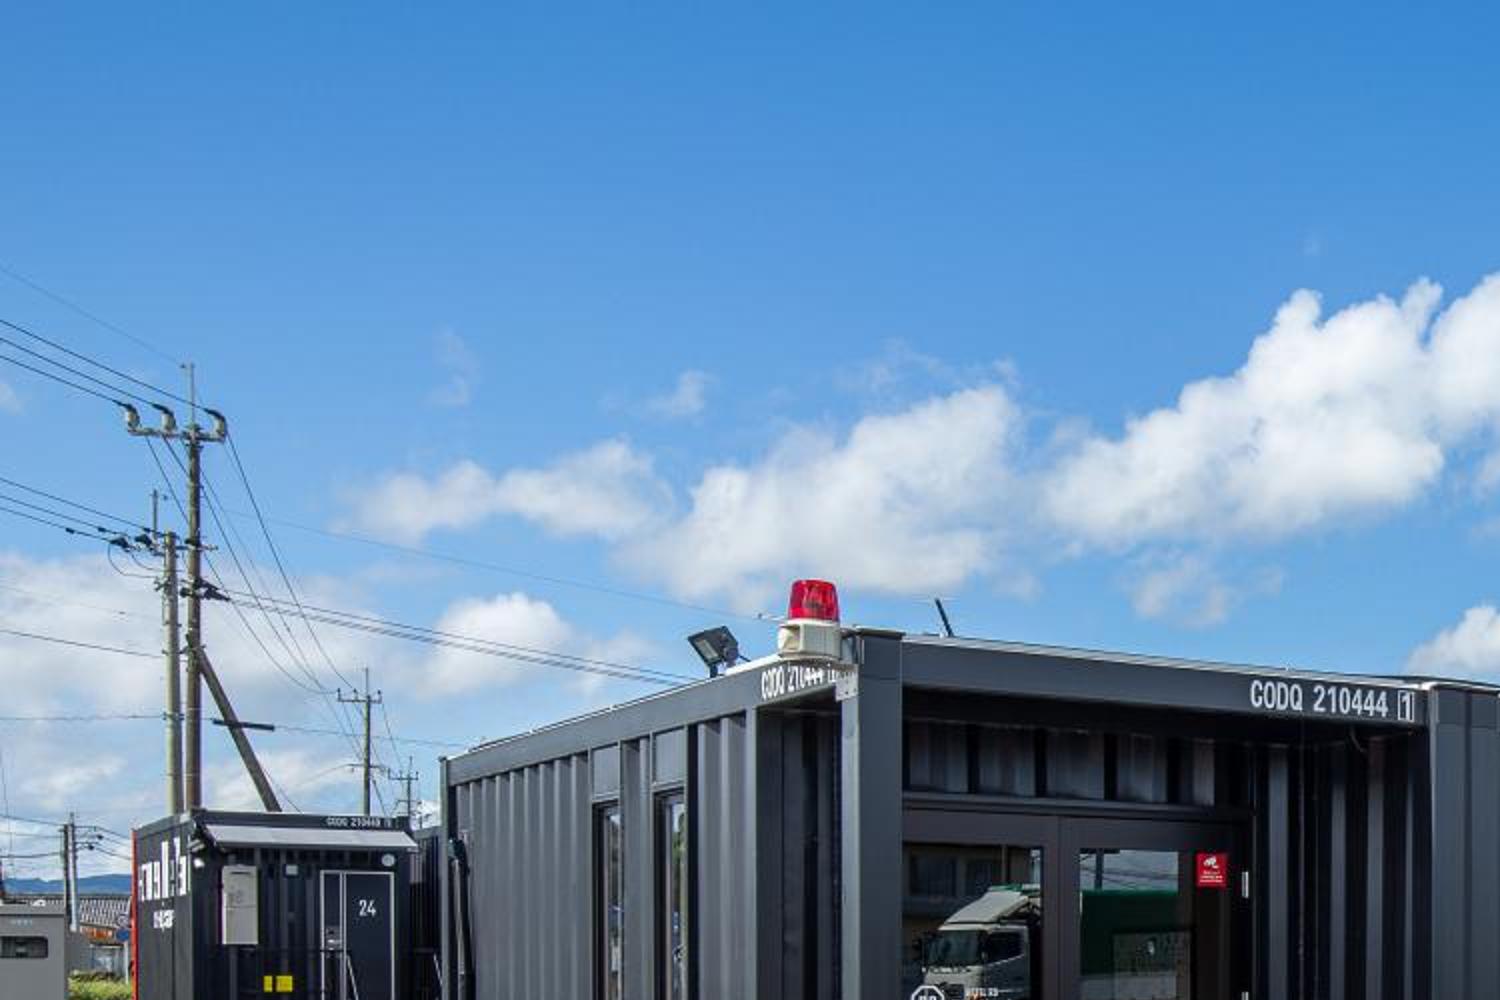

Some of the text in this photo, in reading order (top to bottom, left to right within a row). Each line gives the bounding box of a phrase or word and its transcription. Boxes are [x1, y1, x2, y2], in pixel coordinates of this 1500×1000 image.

[1250, 679, 1414, 721] CODQ 210444 1
[359, 899, 376, 917] 24
